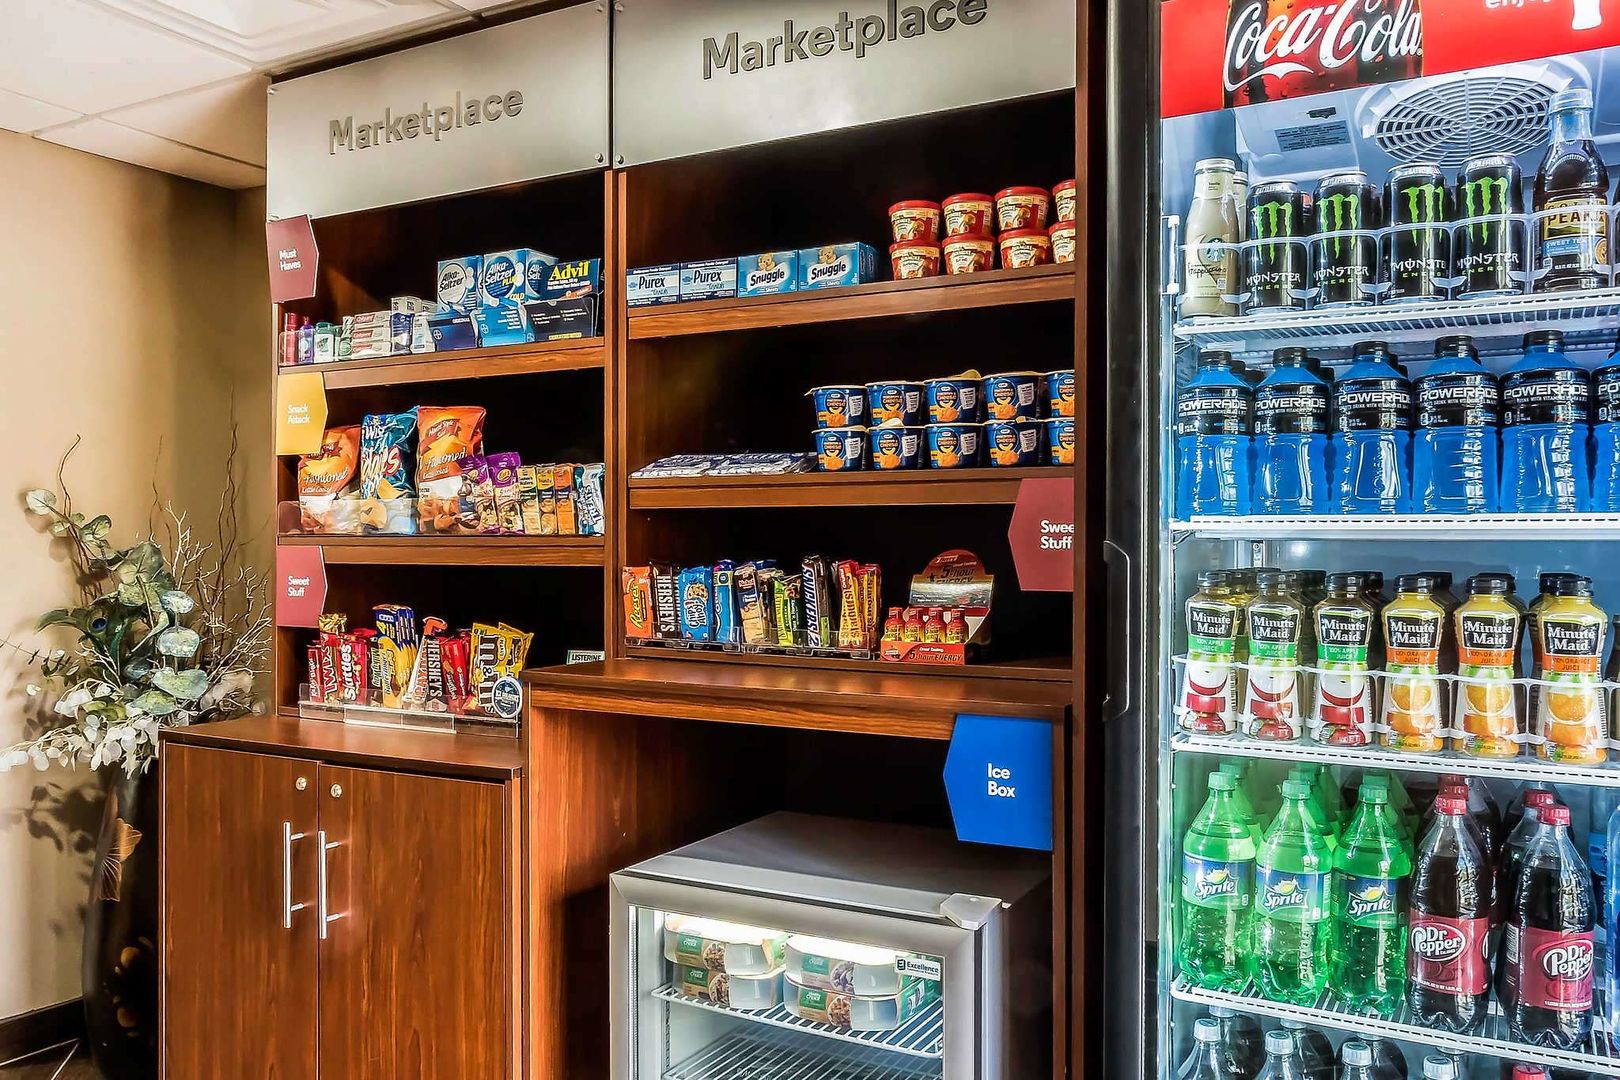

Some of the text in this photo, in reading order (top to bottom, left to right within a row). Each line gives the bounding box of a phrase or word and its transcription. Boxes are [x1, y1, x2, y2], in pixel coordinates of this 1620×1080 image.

[702, 0, 988, 80] Marketplace
[1223, 0, 1424, 92] Coca-Cola
[328, 89, 524, 156] Marketplace
[278, 249, 297, 260] Must
[1457, 252, 1520, 269] MONSTER
[279, 259, 301, 272] Haves
[488, 262, 509, 274] Alka-
[548, 260, 590, 281] Advil
[810, 261, 846, 281] Snuggle
[485, 268, 514, 285] Seltzer
[693, 269, 722, 284] Purex
[750, 268, 785, 287] Snuggle
[1246, 271, 1300, 286] MONSTER
[1313, 265, 1370, 283] MONSTER
[439, 277, 464, 293] Seltzer
[638, 276, 666, 290] Purex
[1419, 386, 1498, 402] POWERADE
[1503, 383, 1588, 400] POWERADE
[287, 403, 308, 414] Snack
[1178, 399, 1248, 413] POWERADE
[1255, 397, 1326, 409] POWERADE
[287, 414, 311, 425] Attack
[1040, 519, 1075, 533] Swee
[1040, 535, 1073, 550] Stuff
[287, 575, 310, 586] Sweet
[287, 586, 305, 598] Stuff
[1192, 612, 1232, 625] Minute
[1253, 615, 1295, 628] Minute
[1324, 618, 1366, 631] Minute
[1197, 621, 1226, 635] Maid
[1259, 626, 1290, 639] Maid
[1390, 620, 1435, 633] Minute
[1466, 620, 1513, 633] Minute
[1547, 625, 1596, 639] Minute
[1329, 629, 1362, 642] Maid
[1396, 632, 1430, 645] Maid
[1472, 632, 1508, 645] Maid
[1554, 638, 1591, 651] Maid
[571, 653, 602, 662] LISTERINE
[341, 643, 357, 702] Skittles
[427, 637, 443, 699] HERSHEY'S
[987, 762, 1011, 780] Ice
[987, 780, 1016, 798] Box
[1195, 880, 1236, 898] Sprite
[1264, 892, 1306, 910] Sprite
[1348, 897, 1393, 917] Sprite
[1412, 926, 1463, 956] Pepper
[1426, 926, 1448, 942] Dr
[1567, 945, 1586, 962] Dr
[907, 961, 939, 973] Excellence
